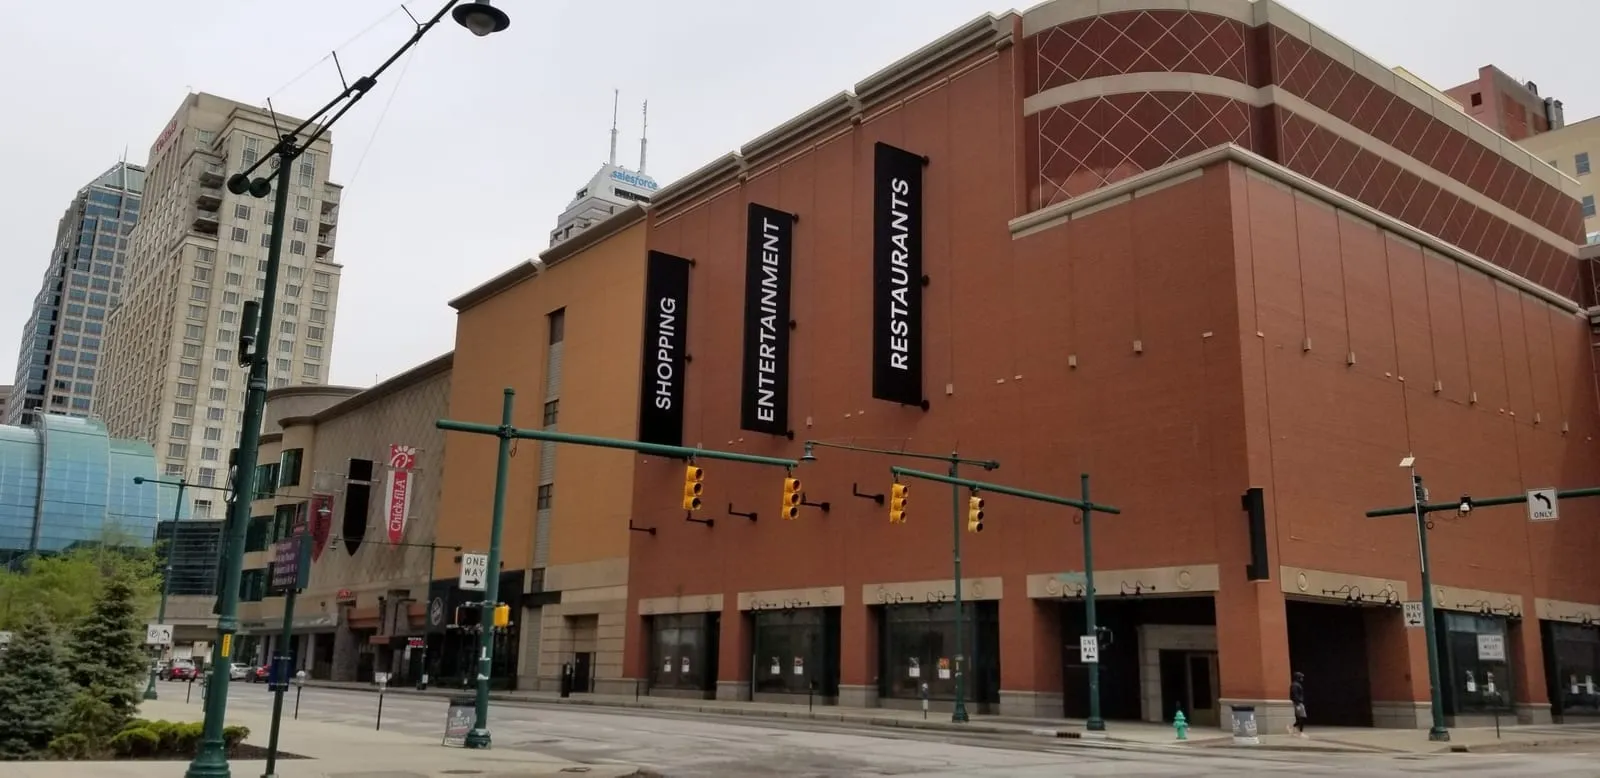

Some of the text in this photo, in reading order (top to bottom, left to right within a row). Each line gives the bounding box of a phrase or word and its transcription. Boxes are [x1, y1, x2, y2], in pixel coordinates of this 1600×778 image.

[611, 170, 658, 190] salesforce
[891, 178, 909, 370] RESTAURANTS
[757, 217, 779, 421] ENTERTAINMENT
[655, 297, 675, 410] SHOPPING
[390, 479, 406, 532] Chick-fil-A
[1533, 511, 1554, 519] ONLY
[465, 556, 485, 567] ONE
[464, 568, 485, 577] WAY
[1406, 611, 1422, 619] WAY
